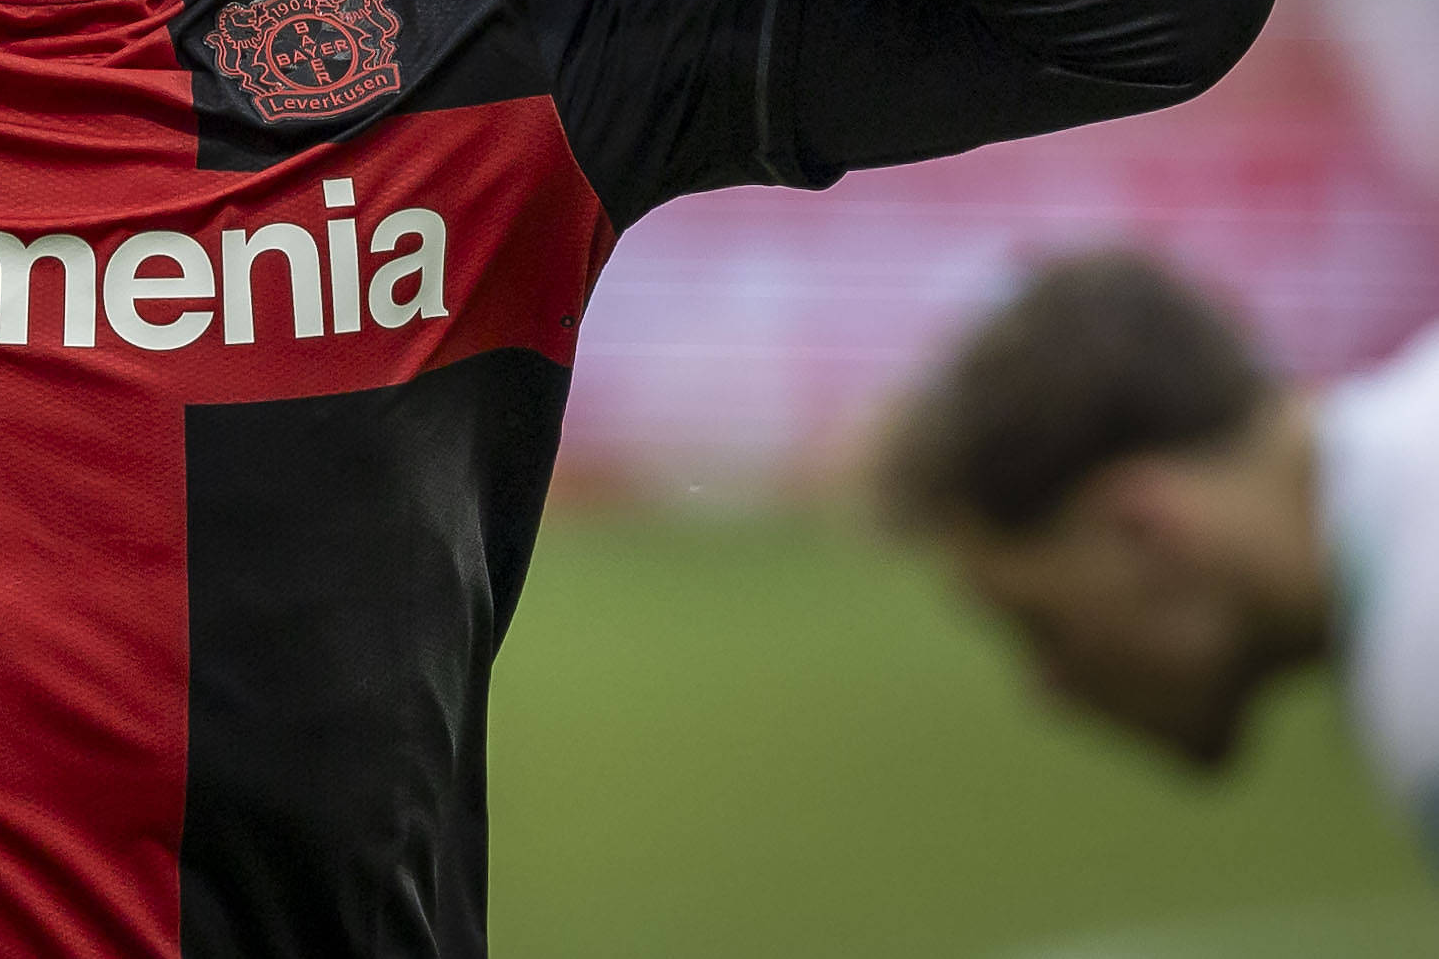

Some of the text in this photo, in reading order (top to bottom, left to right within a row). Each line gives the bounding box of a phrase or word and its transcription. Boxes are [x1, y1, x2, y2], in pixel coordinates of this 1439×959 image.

[275, 39, 349, 69] BAYER
[293, 21, 331, 86] BAYER
[269, 72, 388, 112] Leverkusen
